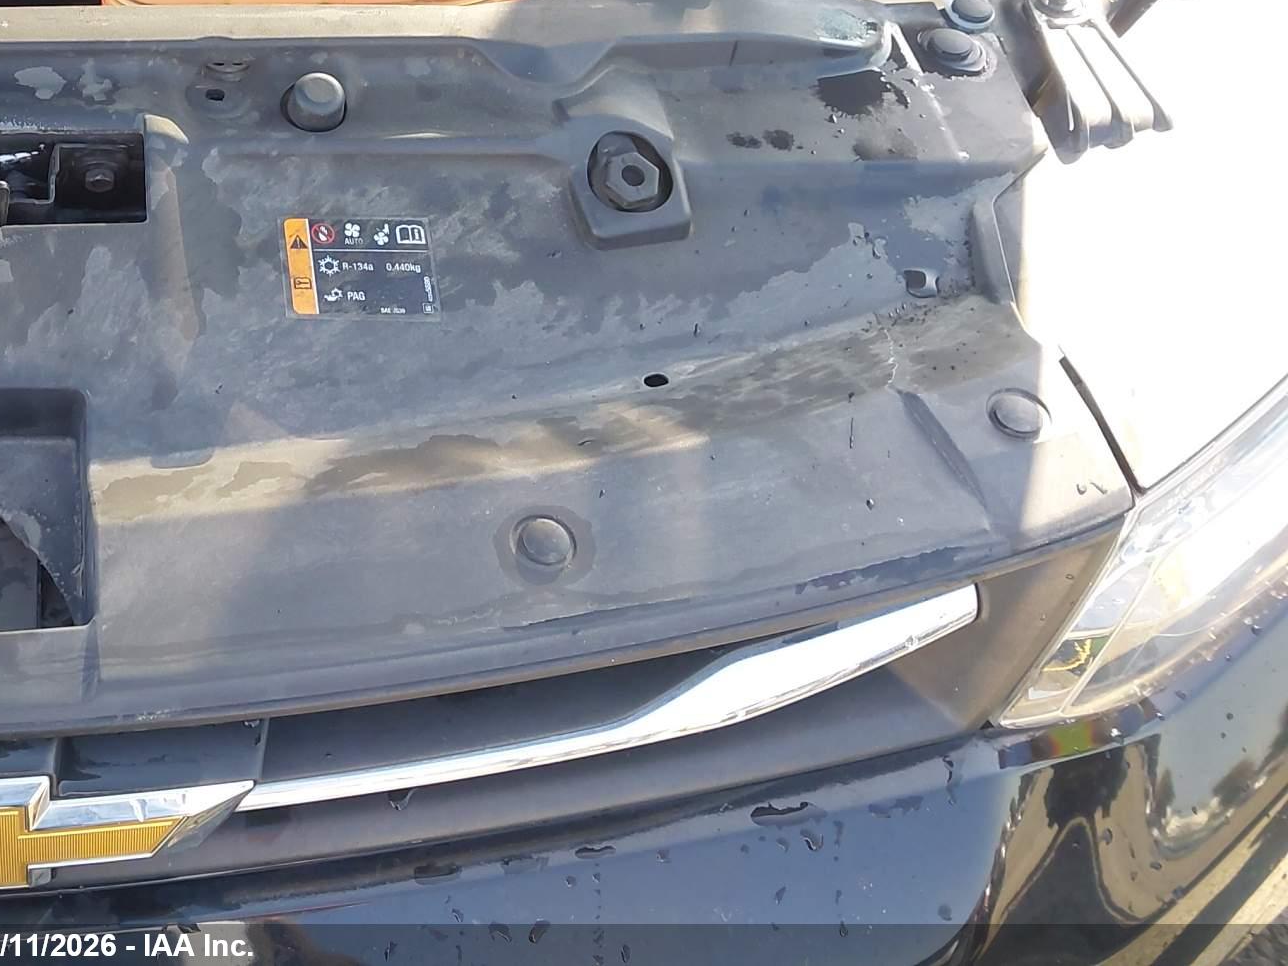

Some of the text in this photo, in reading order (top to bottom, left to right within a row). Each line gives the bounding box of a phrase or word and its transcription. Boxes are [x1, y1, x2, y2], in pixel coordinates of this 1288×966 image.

[344, 237, 364, 245] AUTO
[342, 262, 422, 274] R-134a 0.440kg
[347, 291, 366, 301] PAG
